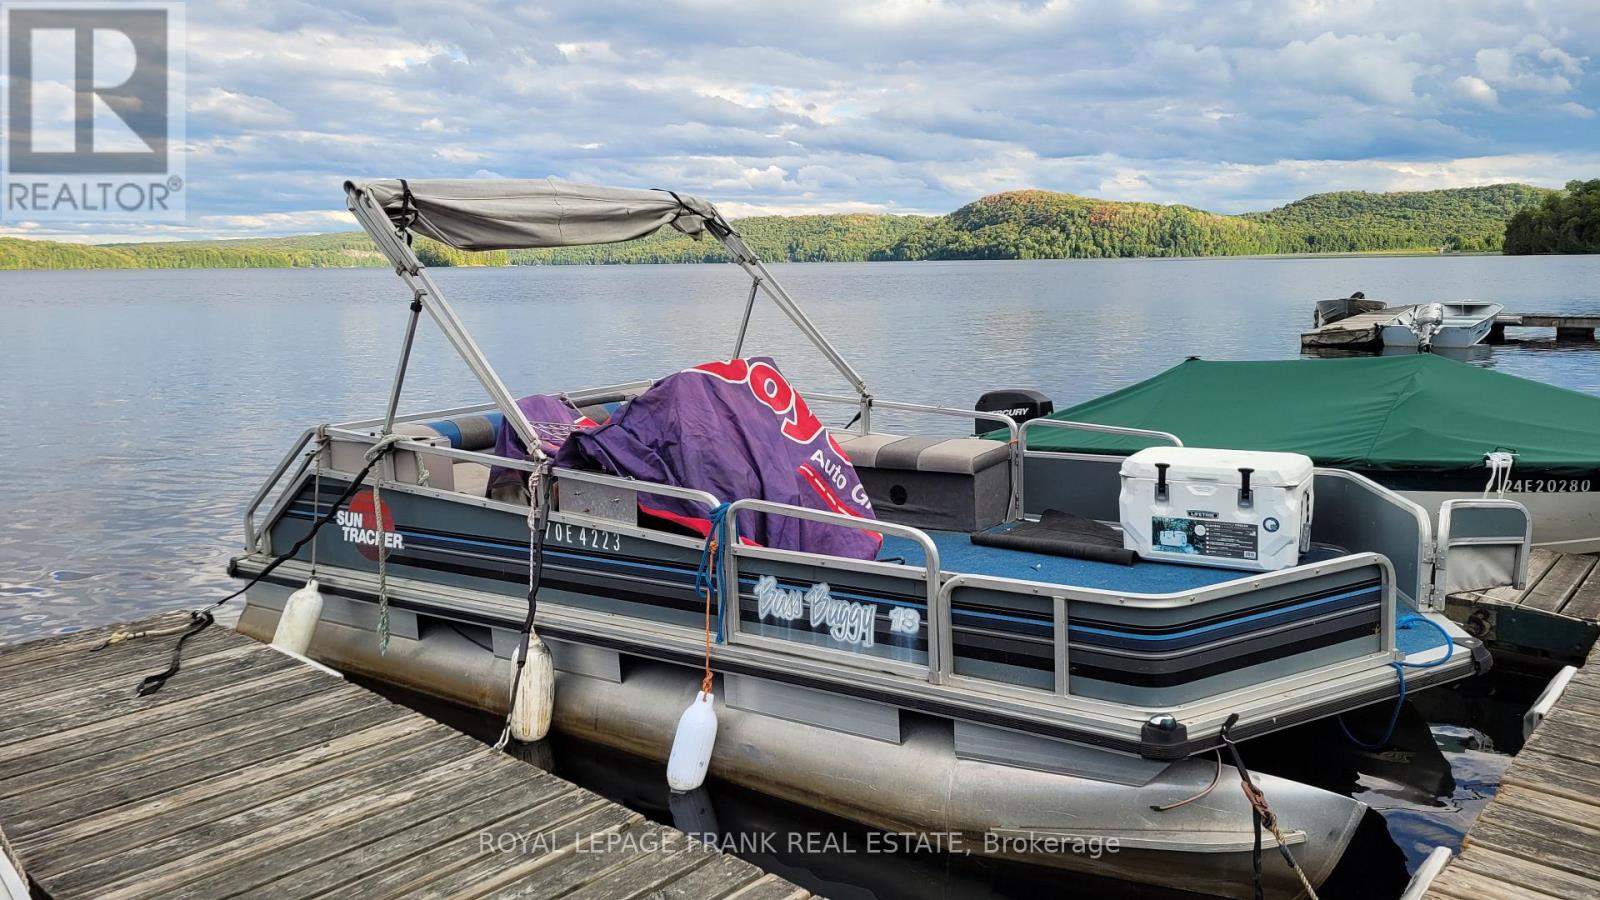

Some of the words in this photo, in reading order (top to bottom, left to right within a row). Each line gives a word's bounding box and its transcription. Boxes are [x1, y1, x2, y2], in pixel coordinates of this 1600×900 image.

[810, 449, 847, 490] Auto
[1504, 479, 1591, 493] 24E20280
[336, 510, 363, 528] SUN
[753, 574, 804, 621] Bass
[804, 582, 878, 648] Buggy
